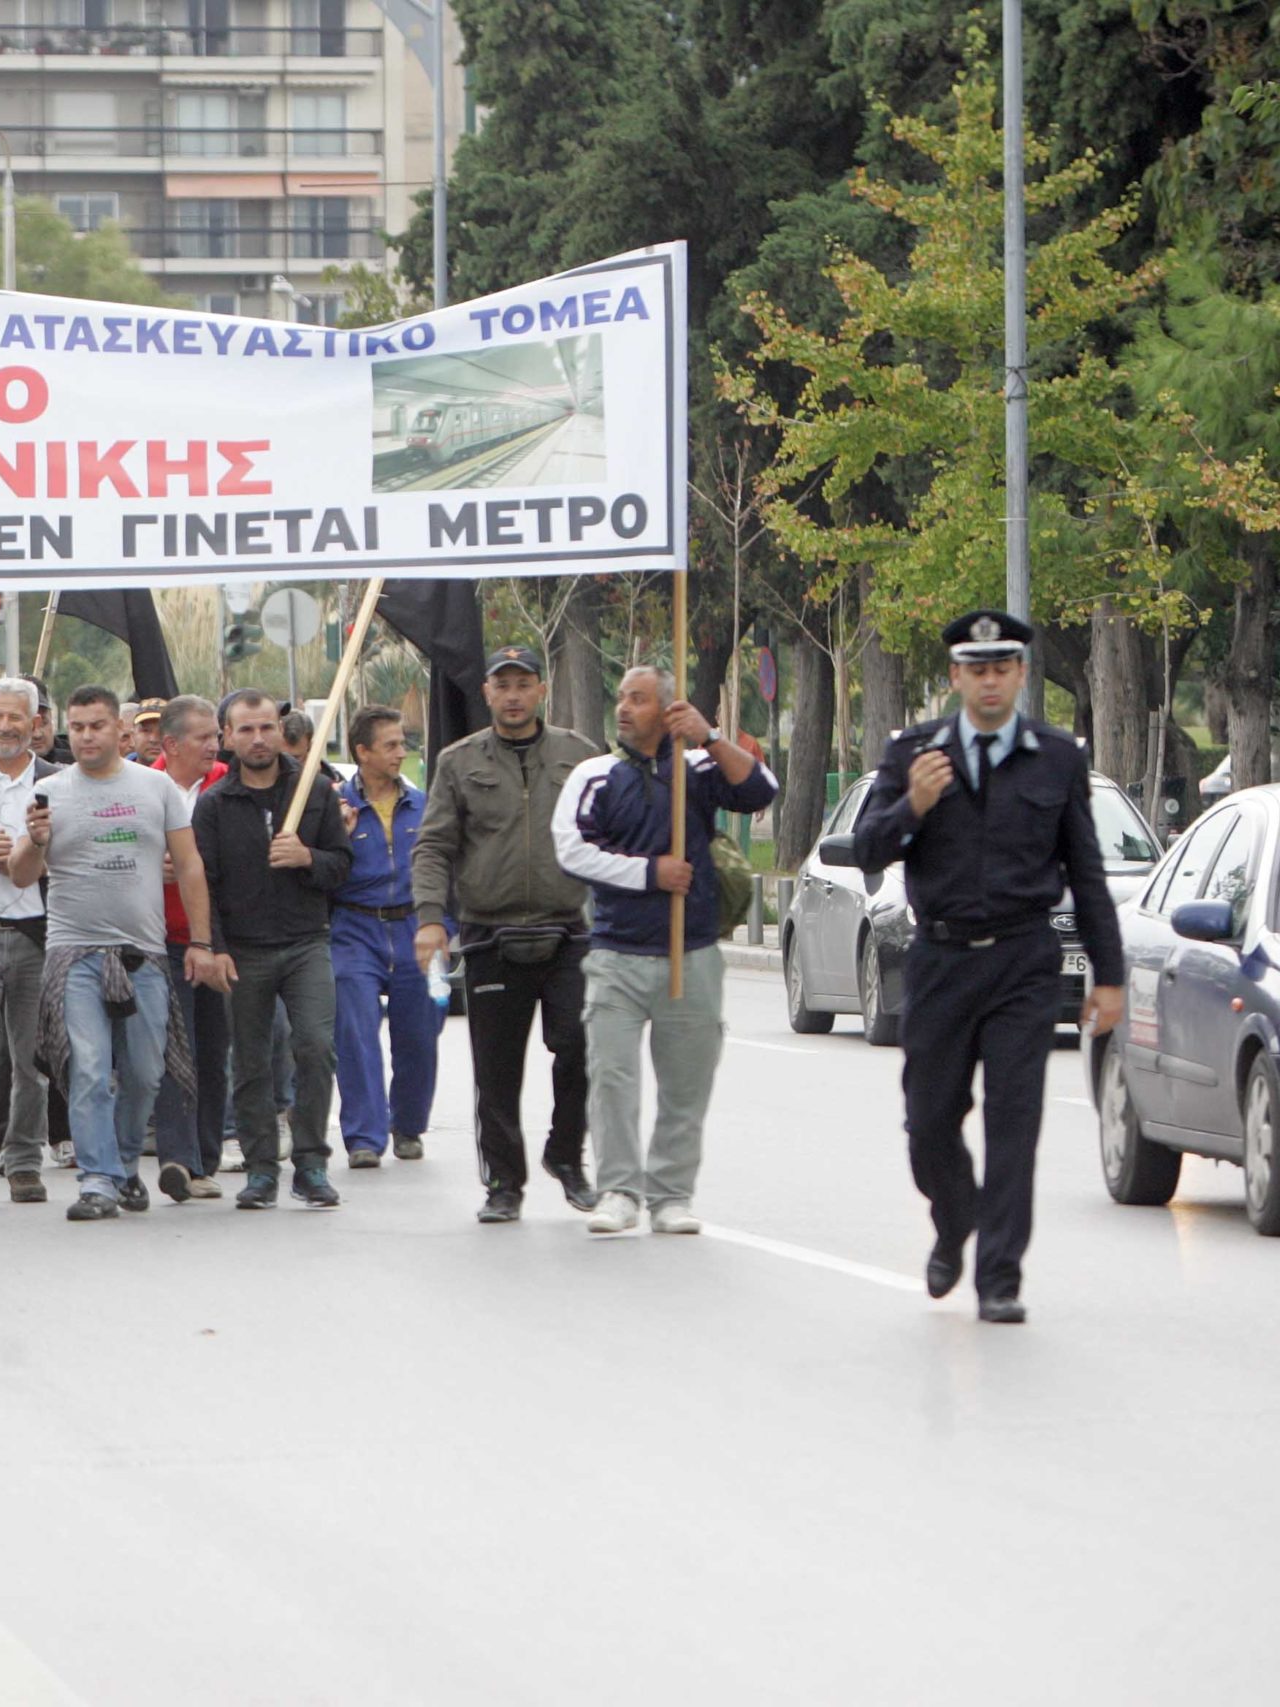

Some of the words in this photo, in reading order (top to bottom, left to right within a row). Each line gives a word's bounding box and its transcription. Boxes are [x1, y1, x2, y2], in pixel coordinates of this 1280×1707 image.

[470, 285, 650, 341] ΤΟΜΕΑ
[121, 506, 379, 558] ΓΙΝΕΤΑΙ
[428, 493, 649, 549] ΜΕΤΡΟ
